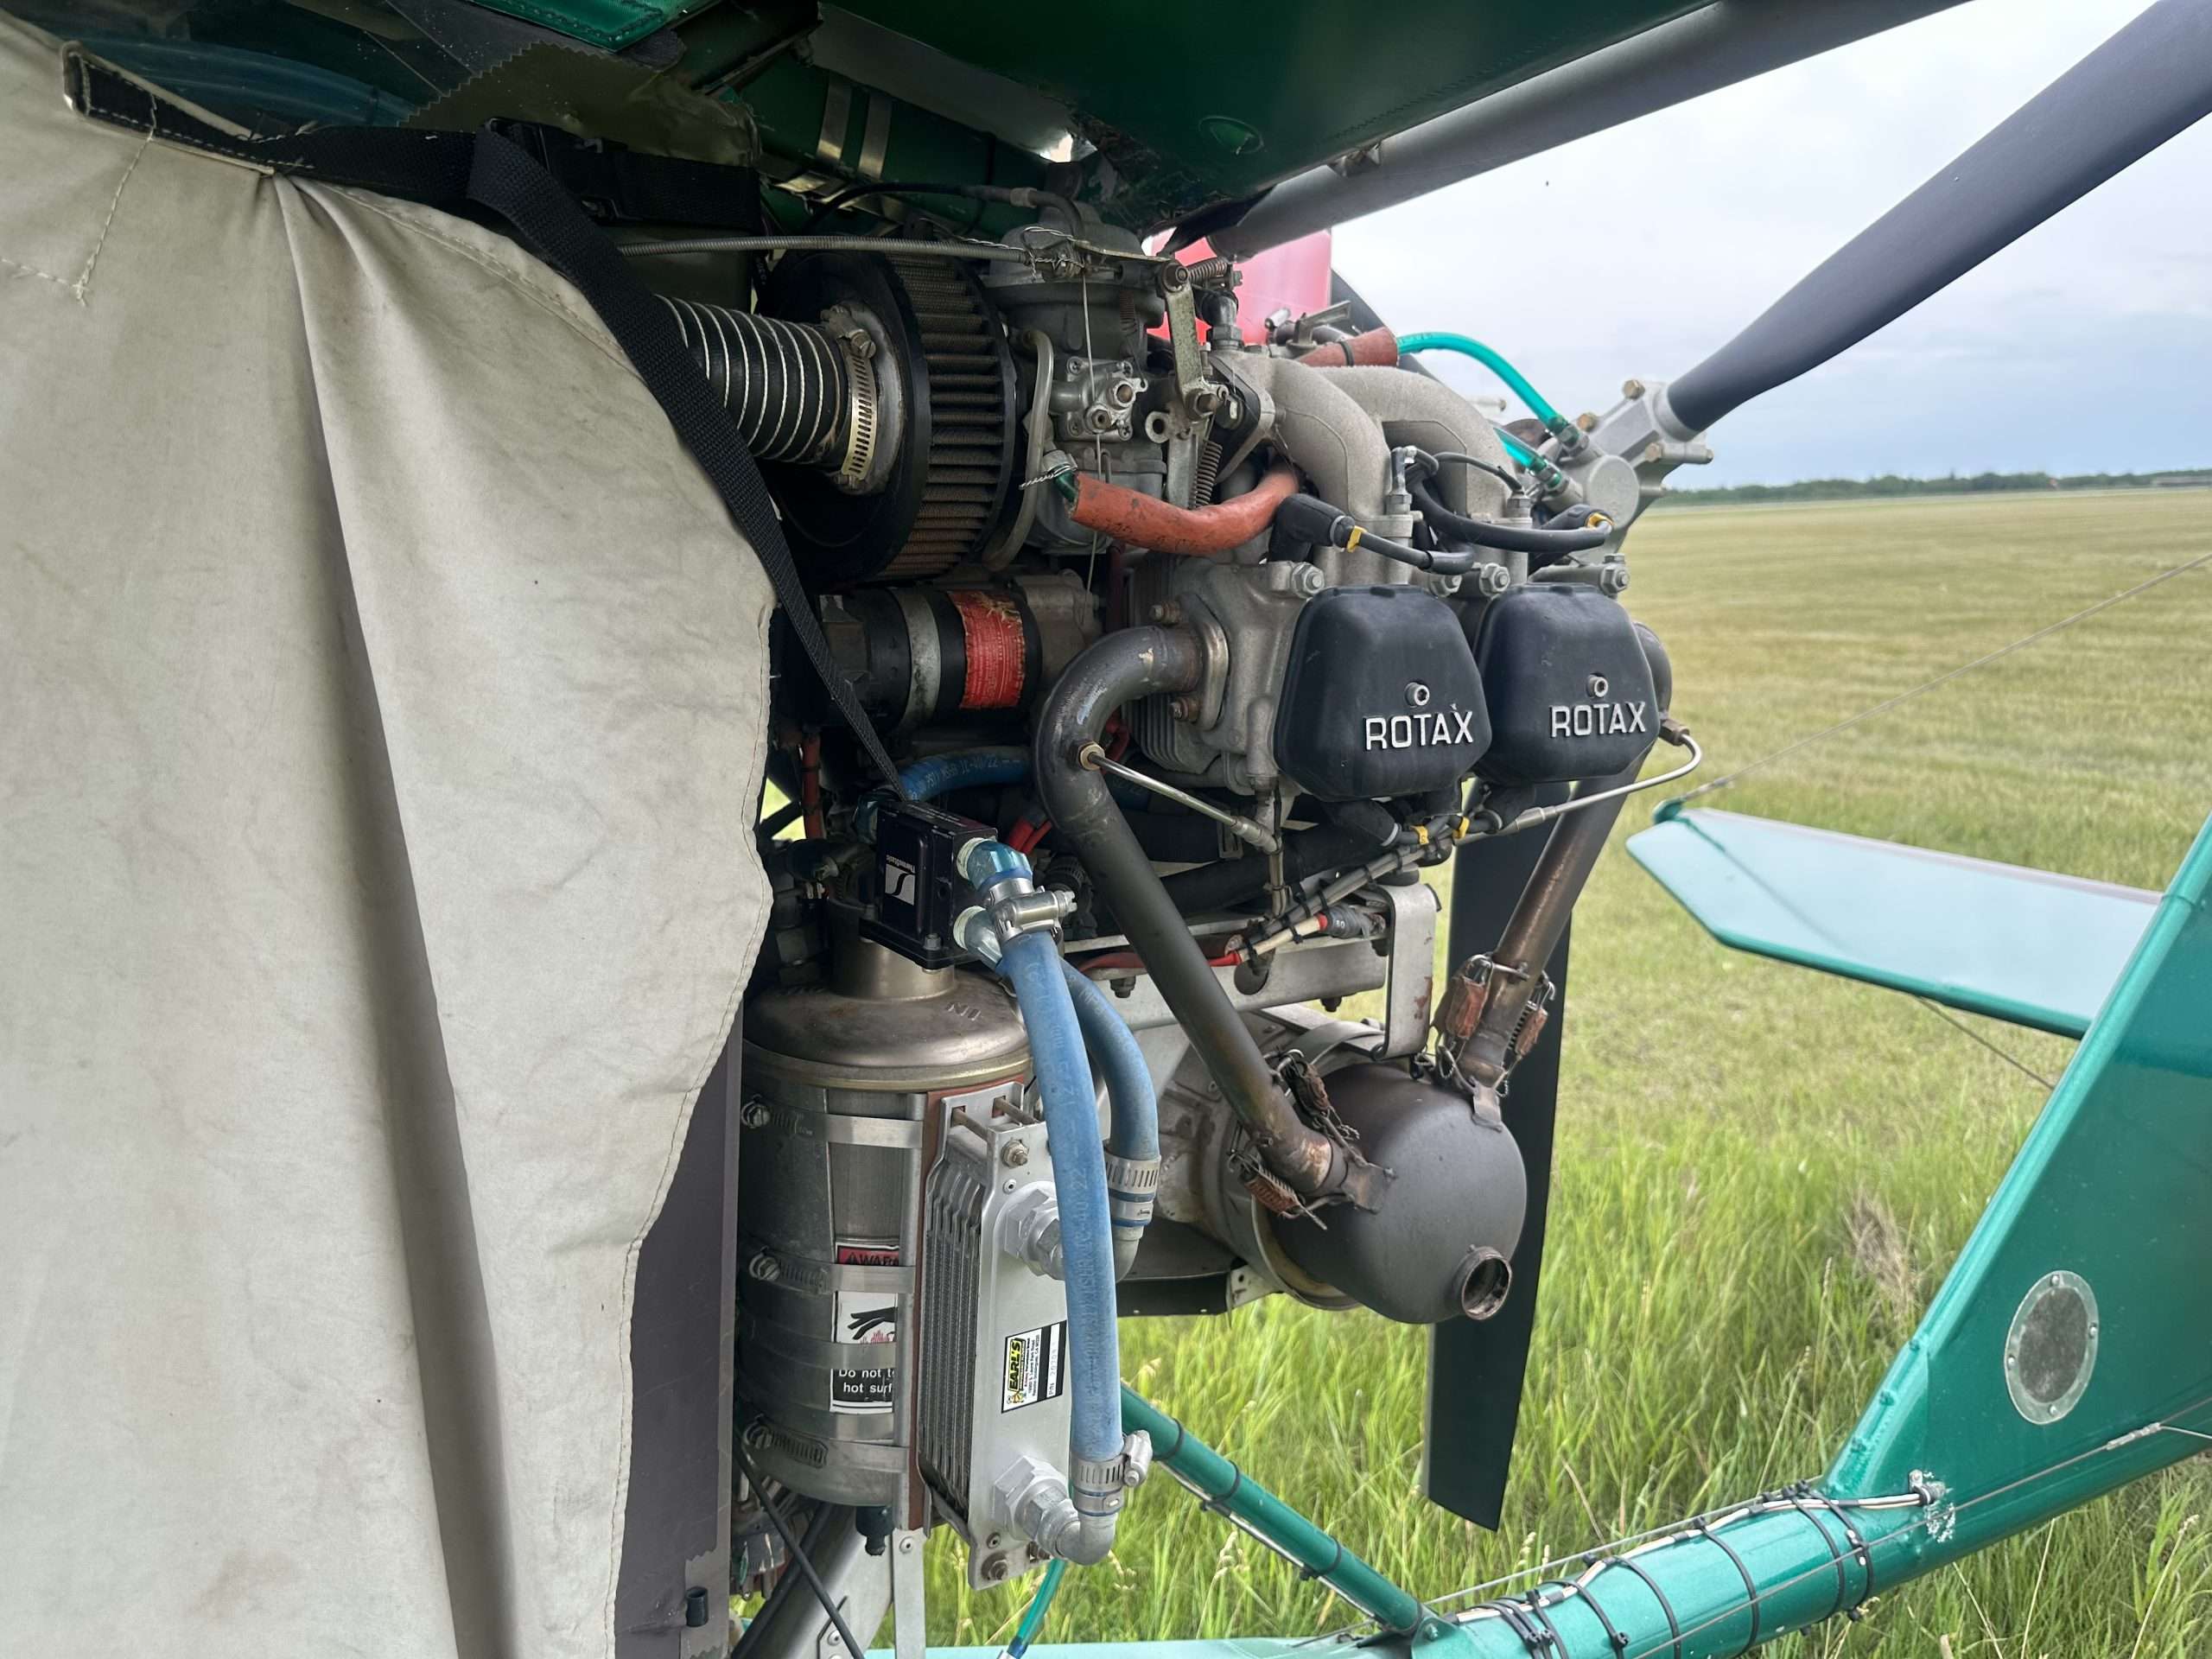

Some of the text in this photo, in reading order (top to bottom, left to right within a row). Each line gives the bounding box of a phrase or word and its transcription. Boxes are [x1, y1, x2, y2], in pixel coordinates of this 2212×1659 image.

[1364, 710, 1473, 750] ROTAX
[1551, 701, 1646, 737] ROTAX
[838, 1369, 856, 1378] Do
[861, 1369, 881, 1378] not
[1009, 1341, 1020, 1390] EARL'S
[843, 1382, 864, 1393] hot
